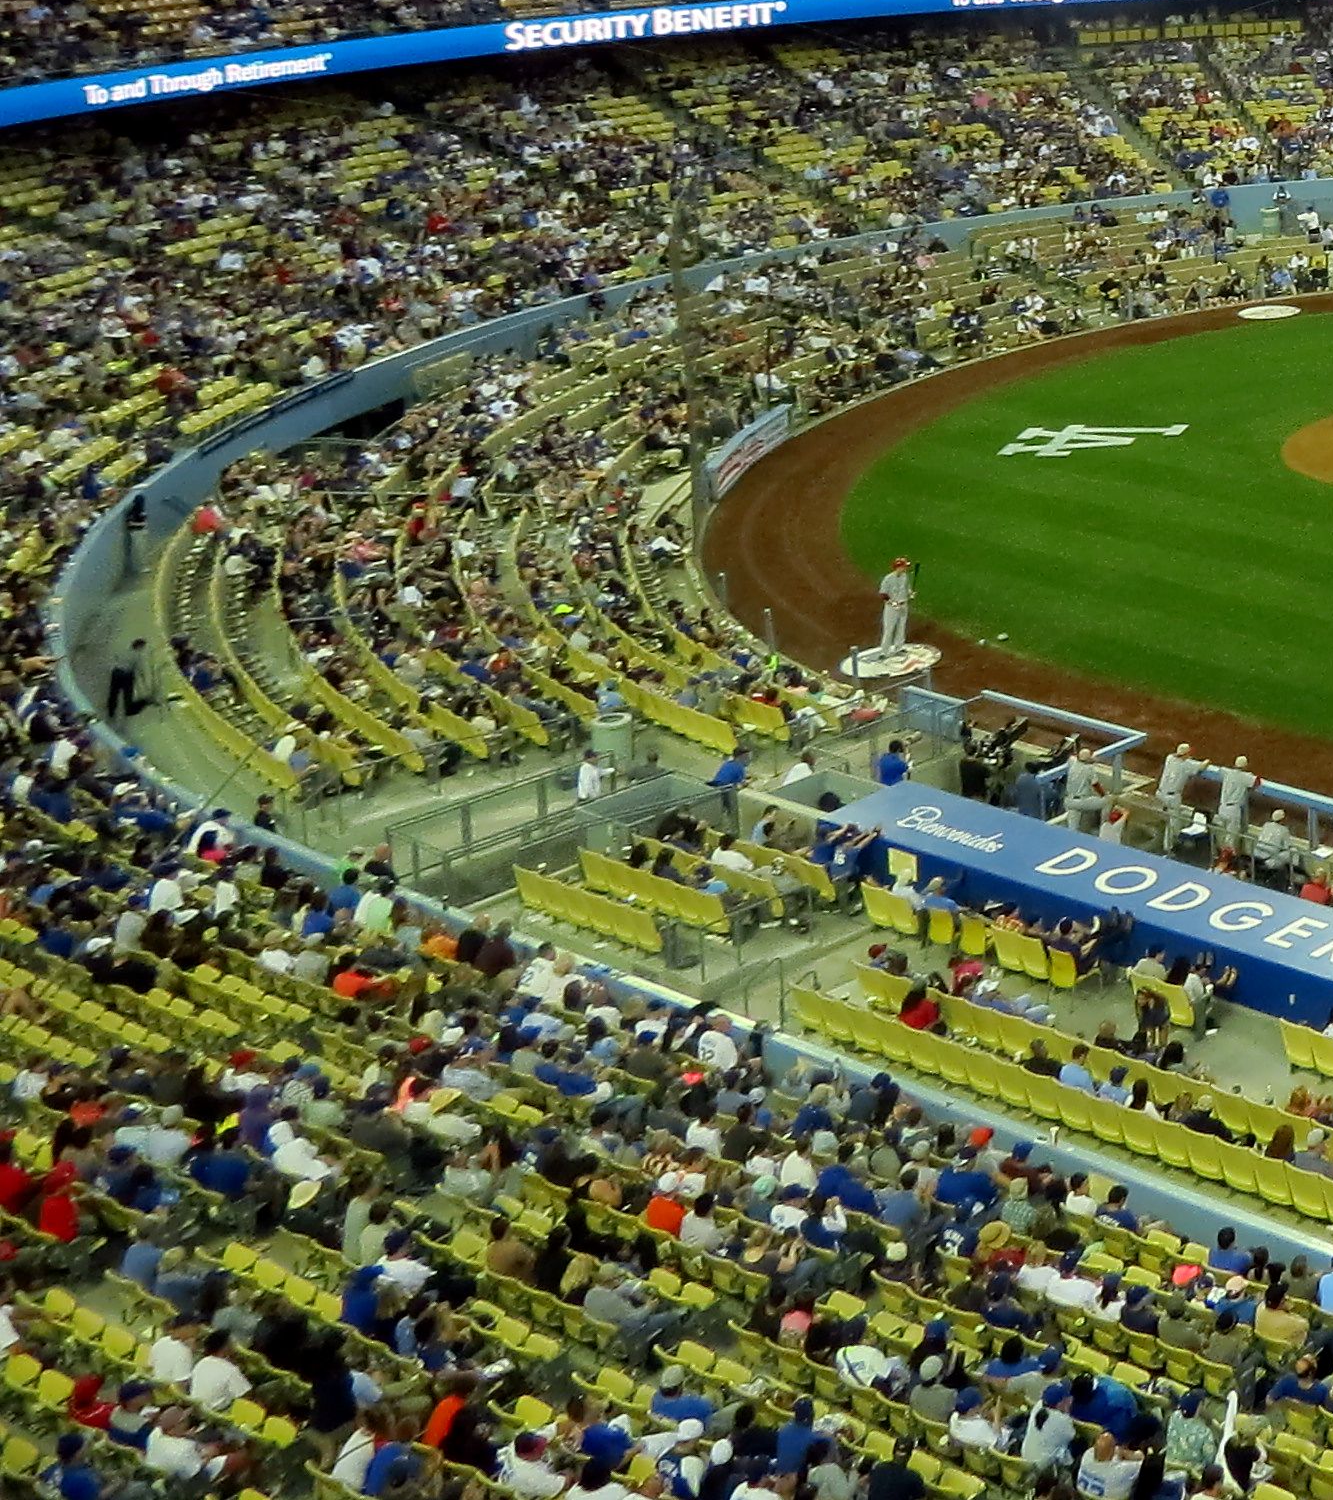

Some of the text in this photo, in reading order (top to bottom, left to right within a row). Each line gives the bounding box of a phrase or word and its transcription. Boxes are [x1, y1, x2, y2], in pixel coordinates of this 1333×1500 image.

[504, 12, 650, 51] SECURITY
[82, 84, 109, 105] To
[109, 78, 148, 102] and
[149, 66, 223, 92] Through
